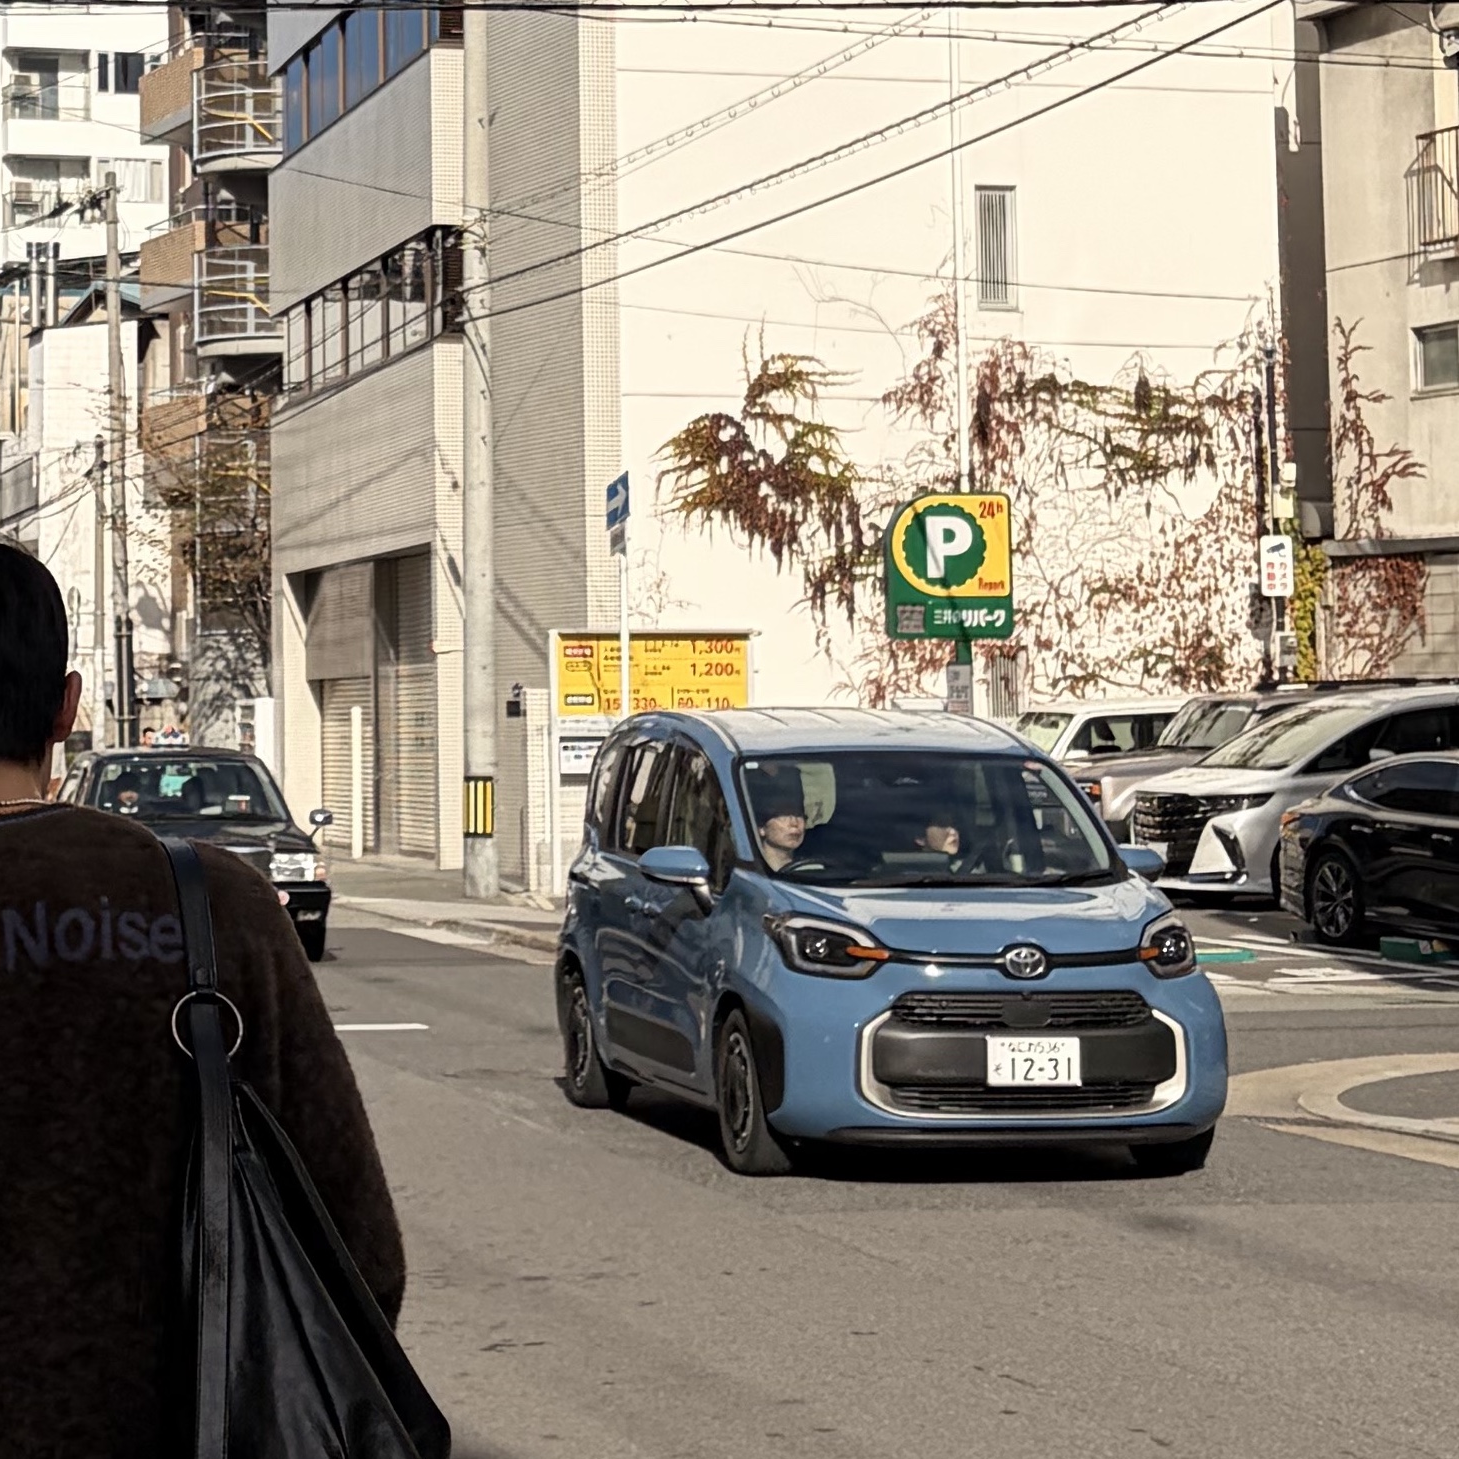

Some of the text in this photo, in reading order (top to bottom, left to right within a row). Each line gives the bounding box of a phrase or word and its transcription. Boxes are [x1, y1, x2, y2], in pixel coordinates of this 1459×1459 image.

[925, 515, 973, 579] P
[933, 608, 1006, 628] 三井のリパーク
[1, 895, 184, 974] Noise
[1011, 1056, 1071, 1081] 12-31
